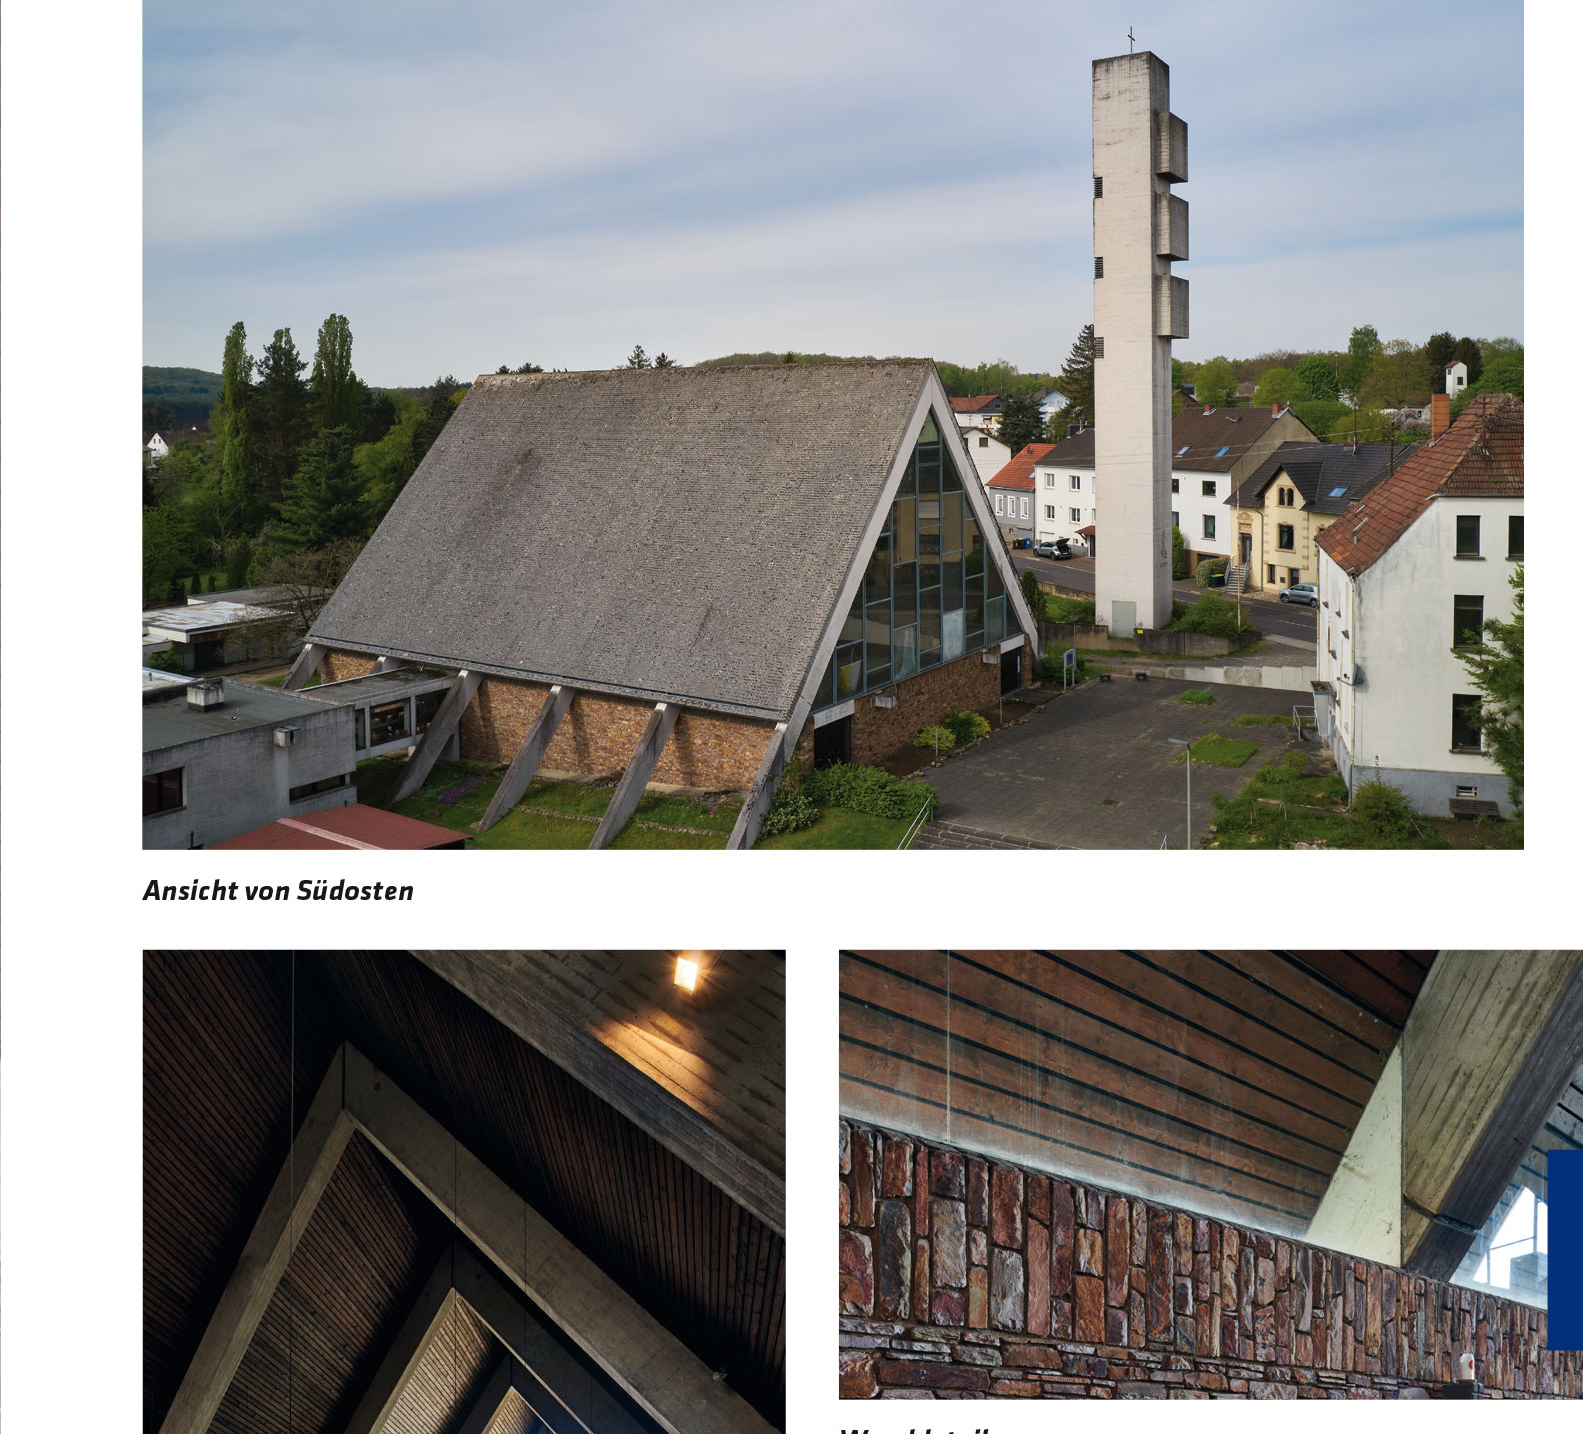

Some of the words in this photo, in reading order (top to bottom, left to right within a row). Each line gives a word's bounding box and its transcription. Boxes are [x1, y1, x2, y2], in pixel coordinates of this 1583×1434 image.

[141, 878, 240, 901] Ansicht
[244, 885, 290, 901] von
[296, 878, 414, 901] Südosten
